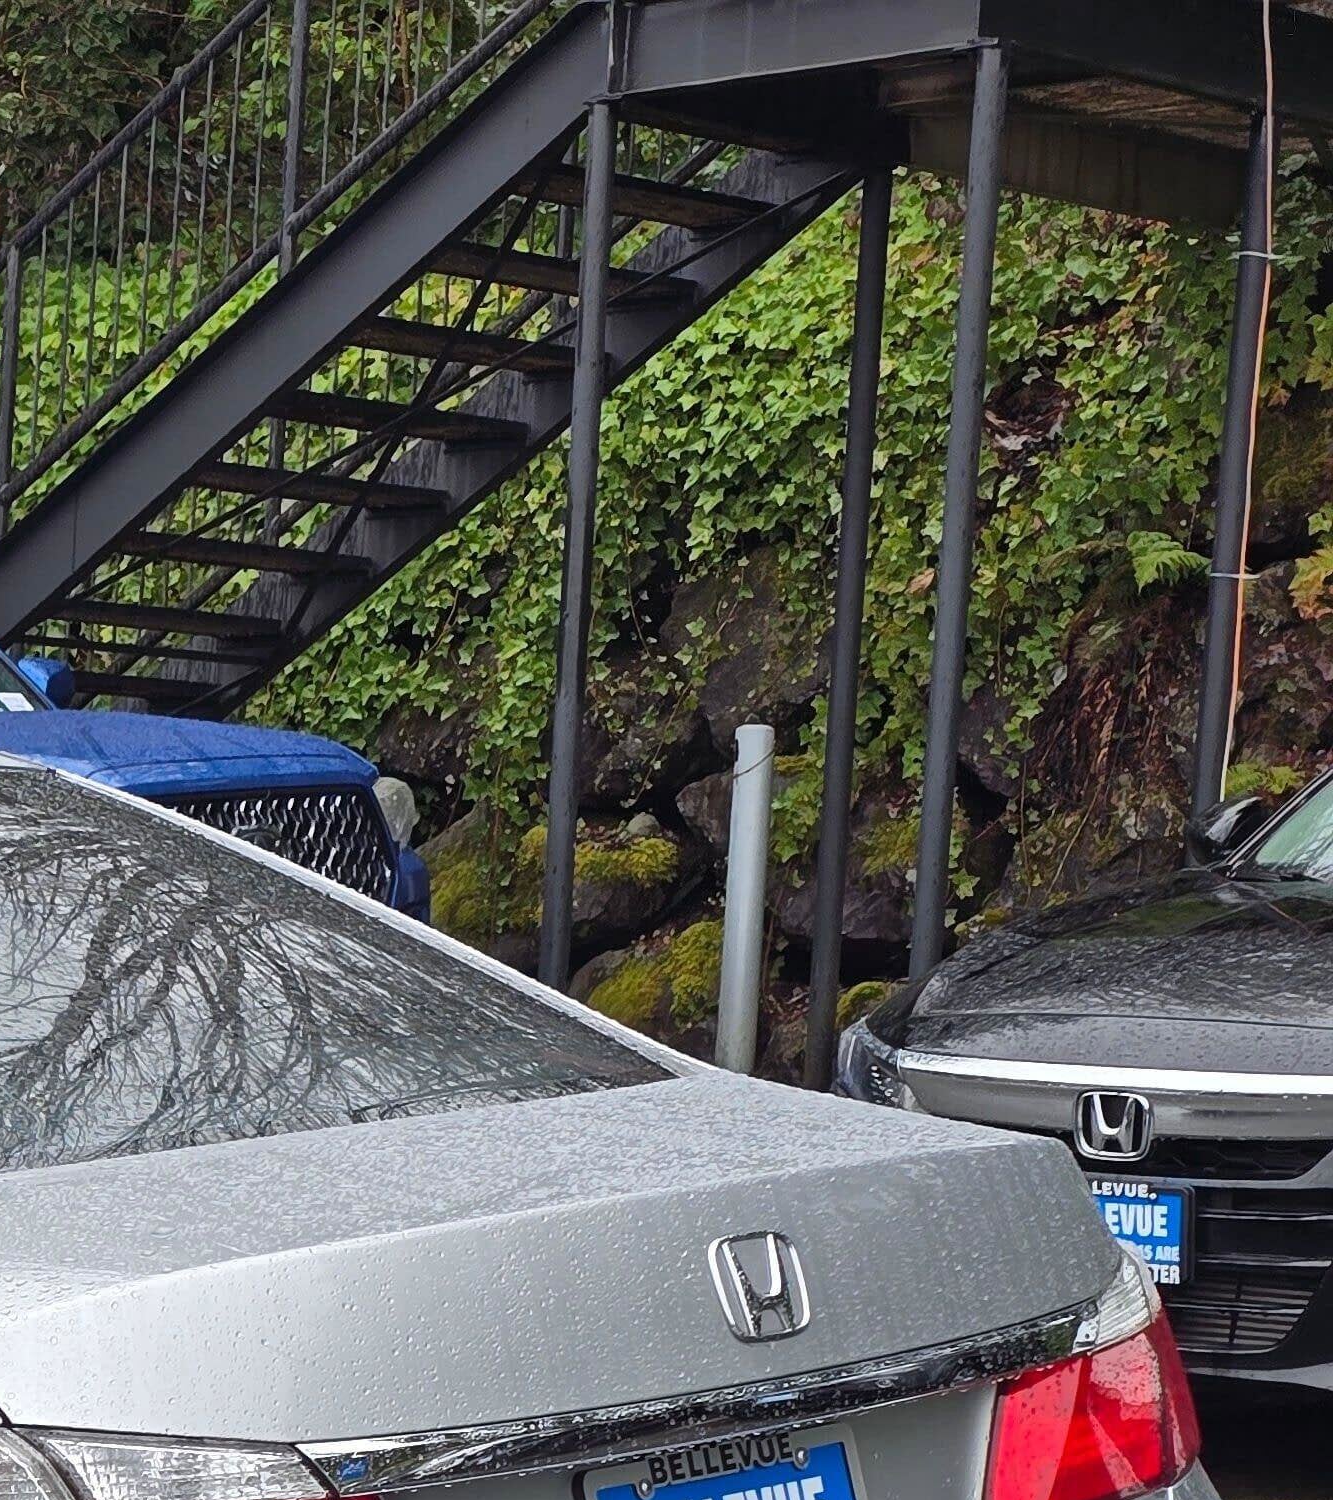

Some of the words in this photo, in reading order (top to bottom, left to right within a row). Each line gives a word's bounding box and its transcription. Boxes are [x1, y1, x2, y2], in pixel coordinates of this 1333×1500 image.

[1092, 1181, 1149, 1198] LEVUE
[1104, 1203, 1168, 1237] EVUE
[1148, 1264, 1180, 1284] TER
[648, 1432, 793, 1483] BELLEVUE
